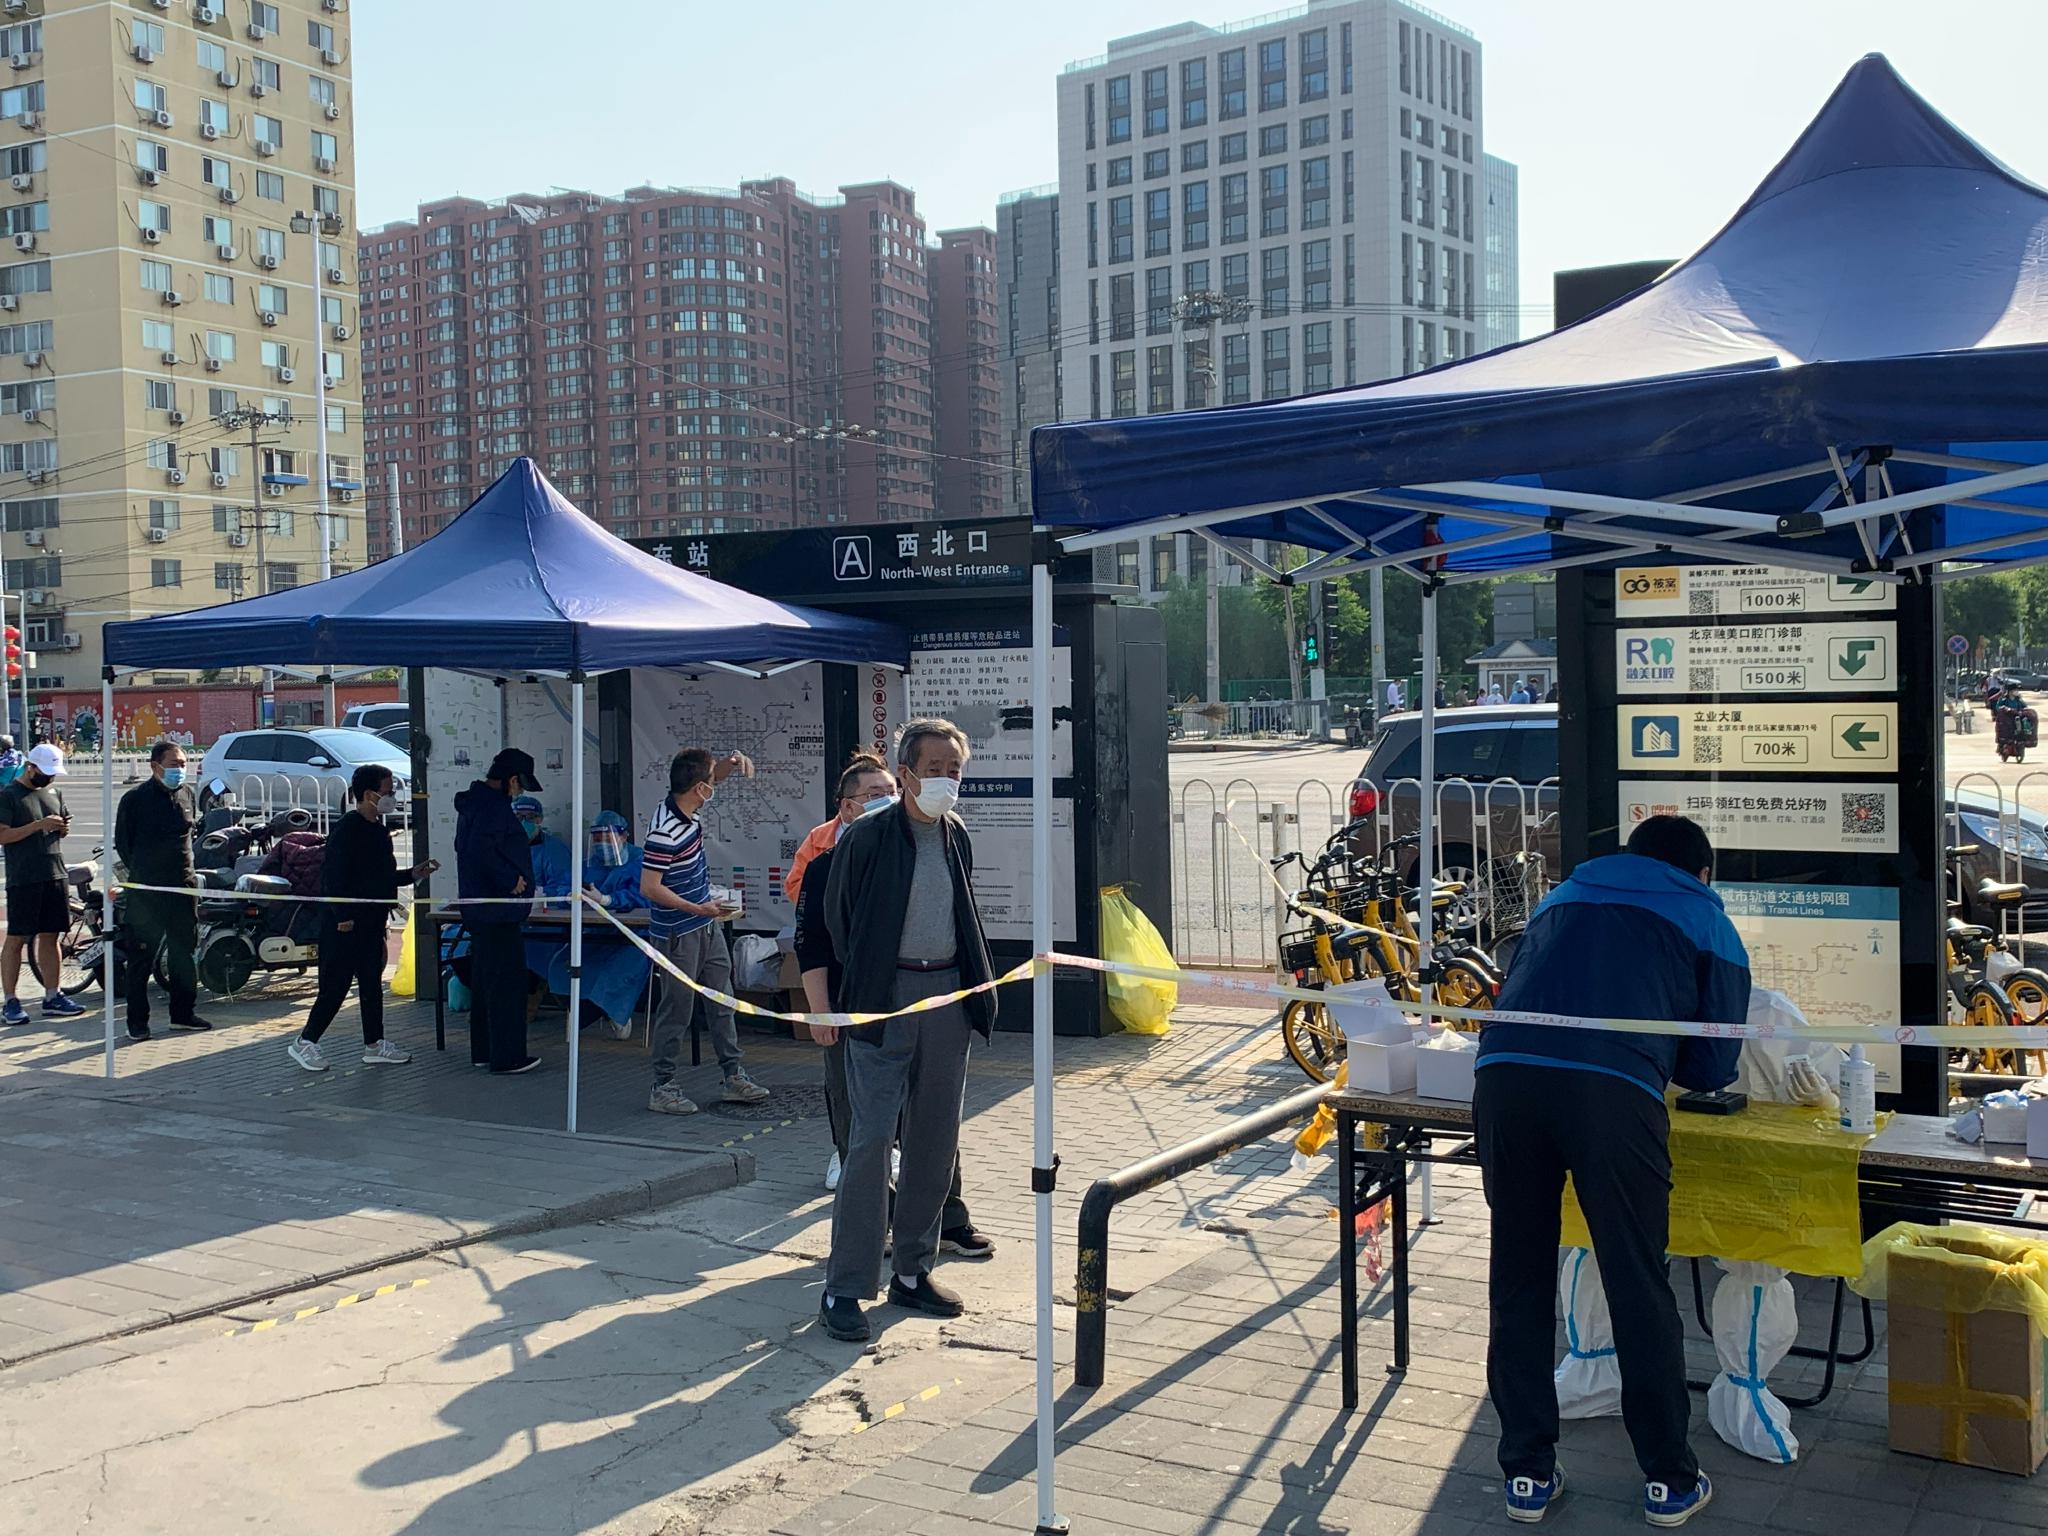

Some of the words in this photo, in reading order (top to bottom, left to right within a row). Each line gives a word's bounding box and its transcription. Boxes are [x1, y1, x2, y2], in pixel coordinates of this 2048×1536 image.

[897, 529, 988, 558] 西北口
[652, 541, 709, 567] 东站
[840, 541, 866, 575] A
[881, 565, 952, 580] North-West
[955, 563, 1010, 576] Entrance
[1746, 592, 1801, 607] 1000米
[1689, 627, 1803, 640] 北京融美口腔门诊部
[1626, 667, 1675, 680] 融美口腔
[1746, 671, 1801, 685] 1500米
[1694, 711, 1742, 723] 立业大厦
[1754, 743, 1796, 756] 700米
[1687, 796, 1827, 811] 扫码领红包免费兑好物
[1768, 905, 1798, 914] Transit
[1800, 906, 1825, 916] Lines
